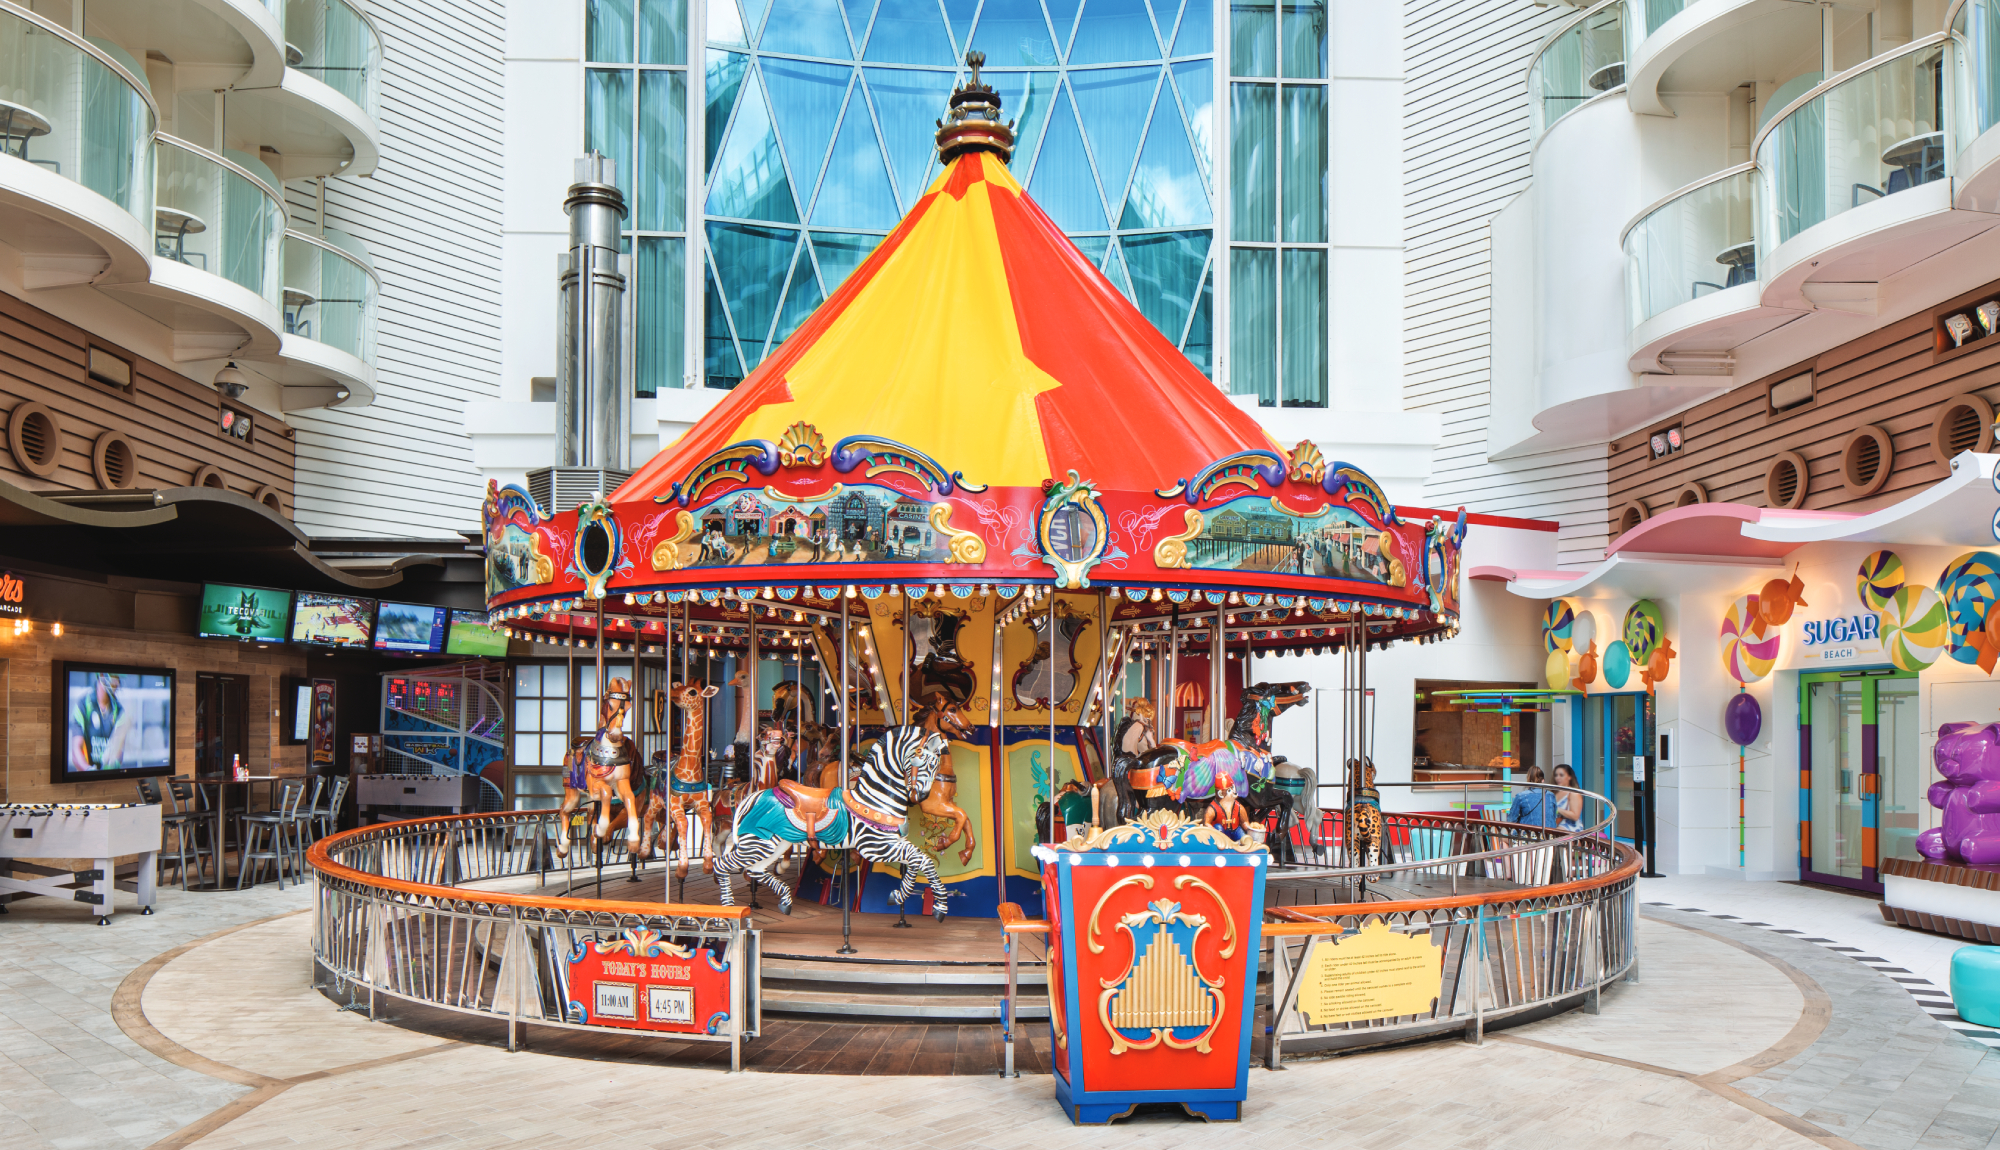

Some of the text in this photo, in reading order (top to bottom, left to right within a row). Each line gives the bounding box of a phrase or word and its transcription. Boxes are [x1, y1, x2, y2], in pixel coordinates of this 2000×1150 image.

[228, 606, 265, 617] TECOVAS
[1803, 614, 1879, 645] SUGAR
[1824, 648, 1852, 659] BEACH
[601, 960, 691, 980] TODAY'S HOURS
[600, 993, 629, 1008] 11:00 AM
[655, 998, 685, 1014] 4:45 PM
